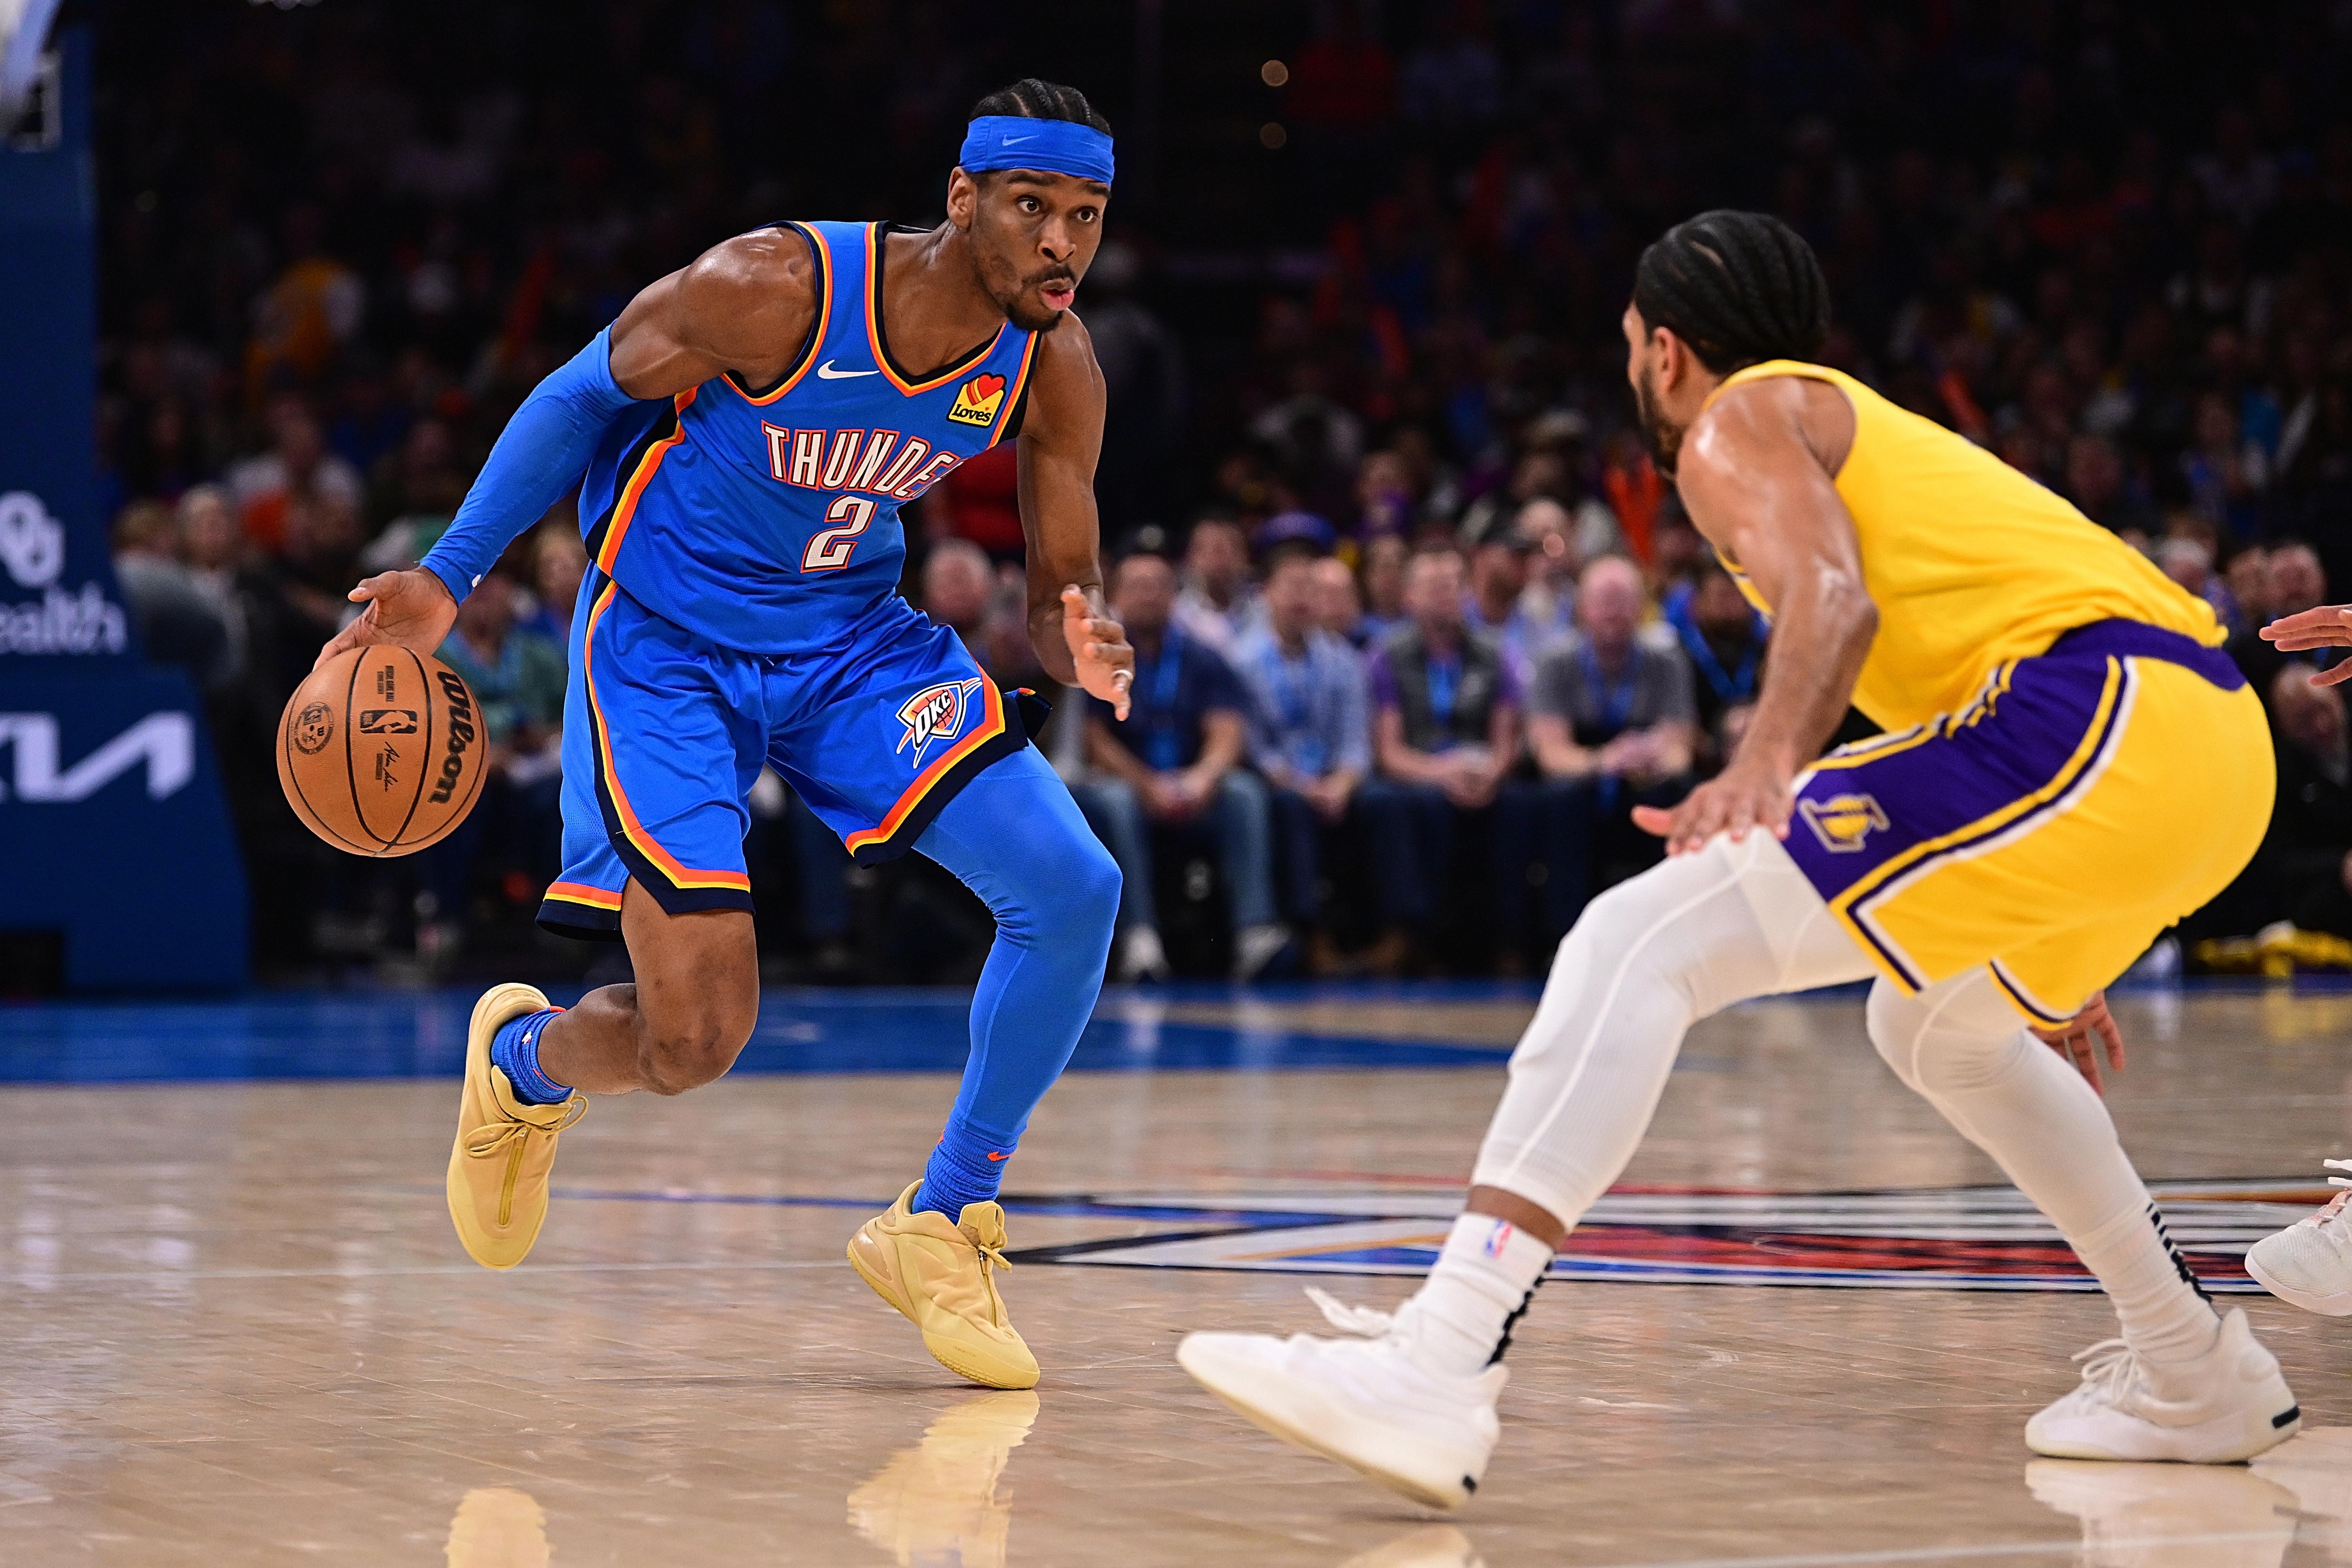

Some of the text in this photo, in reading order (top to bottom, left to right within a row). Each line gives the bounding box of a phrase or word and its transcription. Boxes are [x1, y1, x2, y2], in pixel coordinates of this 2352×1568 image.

[761, 418, 969, 500] THUNDE
[800, 494, 878, 573] 2
[427, 671, 475, 803] Wilson
[914, 690, 952, 746] OKC
